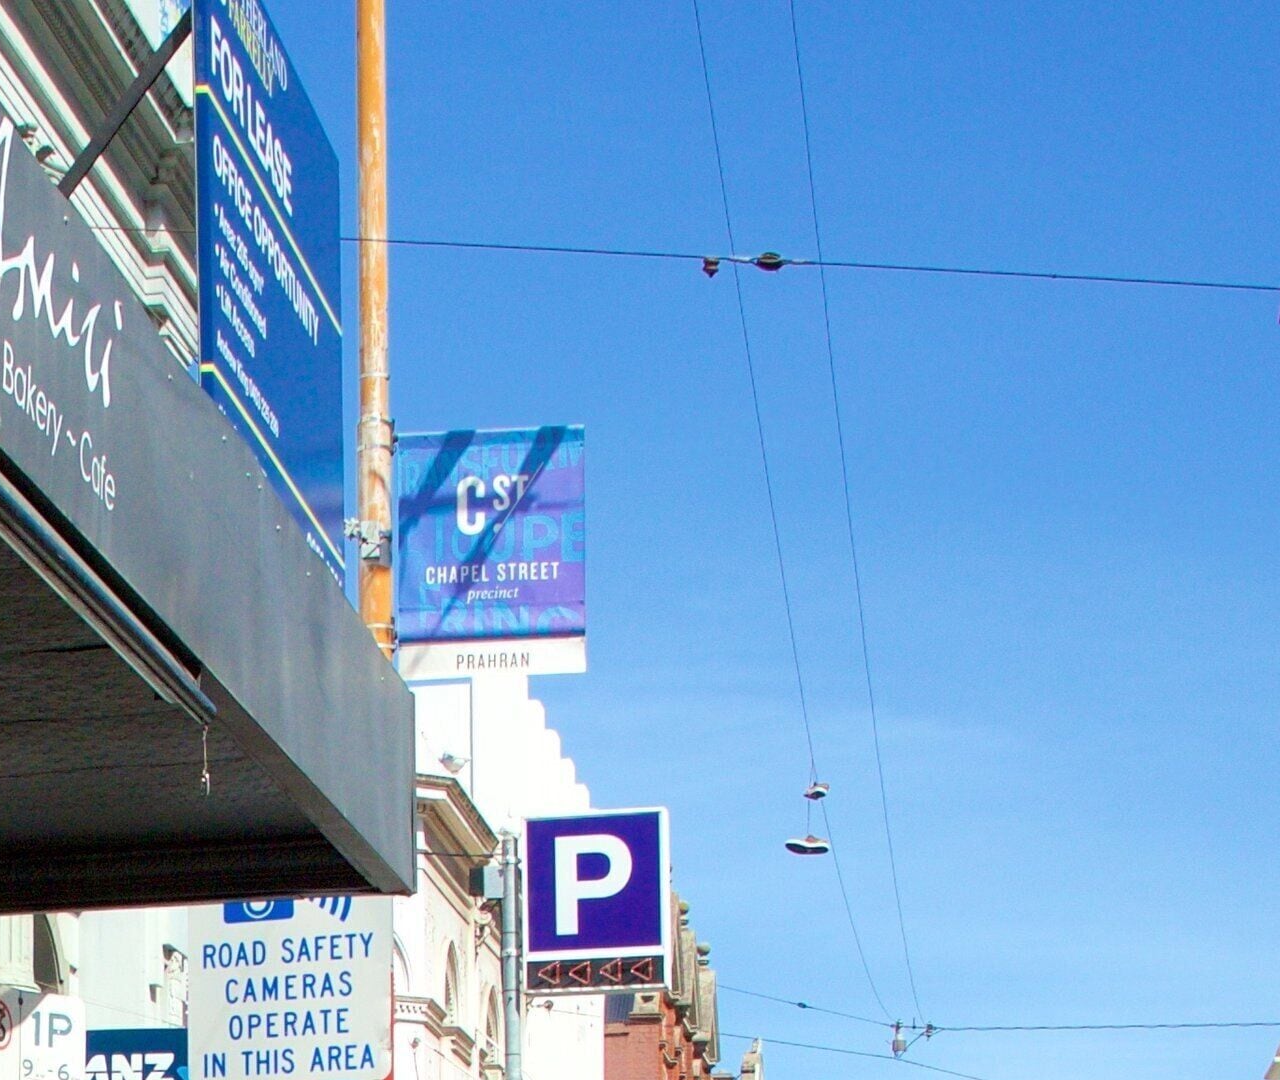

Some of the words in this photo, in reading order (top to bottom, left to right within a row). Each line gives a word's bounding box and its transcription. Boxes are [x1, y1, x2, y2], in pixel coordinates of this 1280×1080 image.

[211, 15, 244, 128] FOR
[247, 83, 292, 217] LEASE
[213, 134, 252, 232] OFFICE
[254, 206, 319, 346] OPPORTUNITY
[1, 340, 64, 456] Bakery
[79, 435, 116, 512] Cafe
[425, 564, 490, 585] CHAPEL
[497, 562, 559, 582] STREET
[467, 586, 519, 604] precinct
[456, 652, 530, 670] PRAHRAN
[555, 834, 632, 936] P
[203, 940, 266, 969] ROAD
[281, 932, 374, 964] SAFETY
[225, 971, 353, 1004] CAMERAS
[31, 1011, 72, 1047] 1P
[228, 1008, 349, 1040] OPERATE
[203, 1053, 226, 1078] IN
[242, 1049, 295, 1076] THIS
[310, 1044, 375, 1072] AREA
